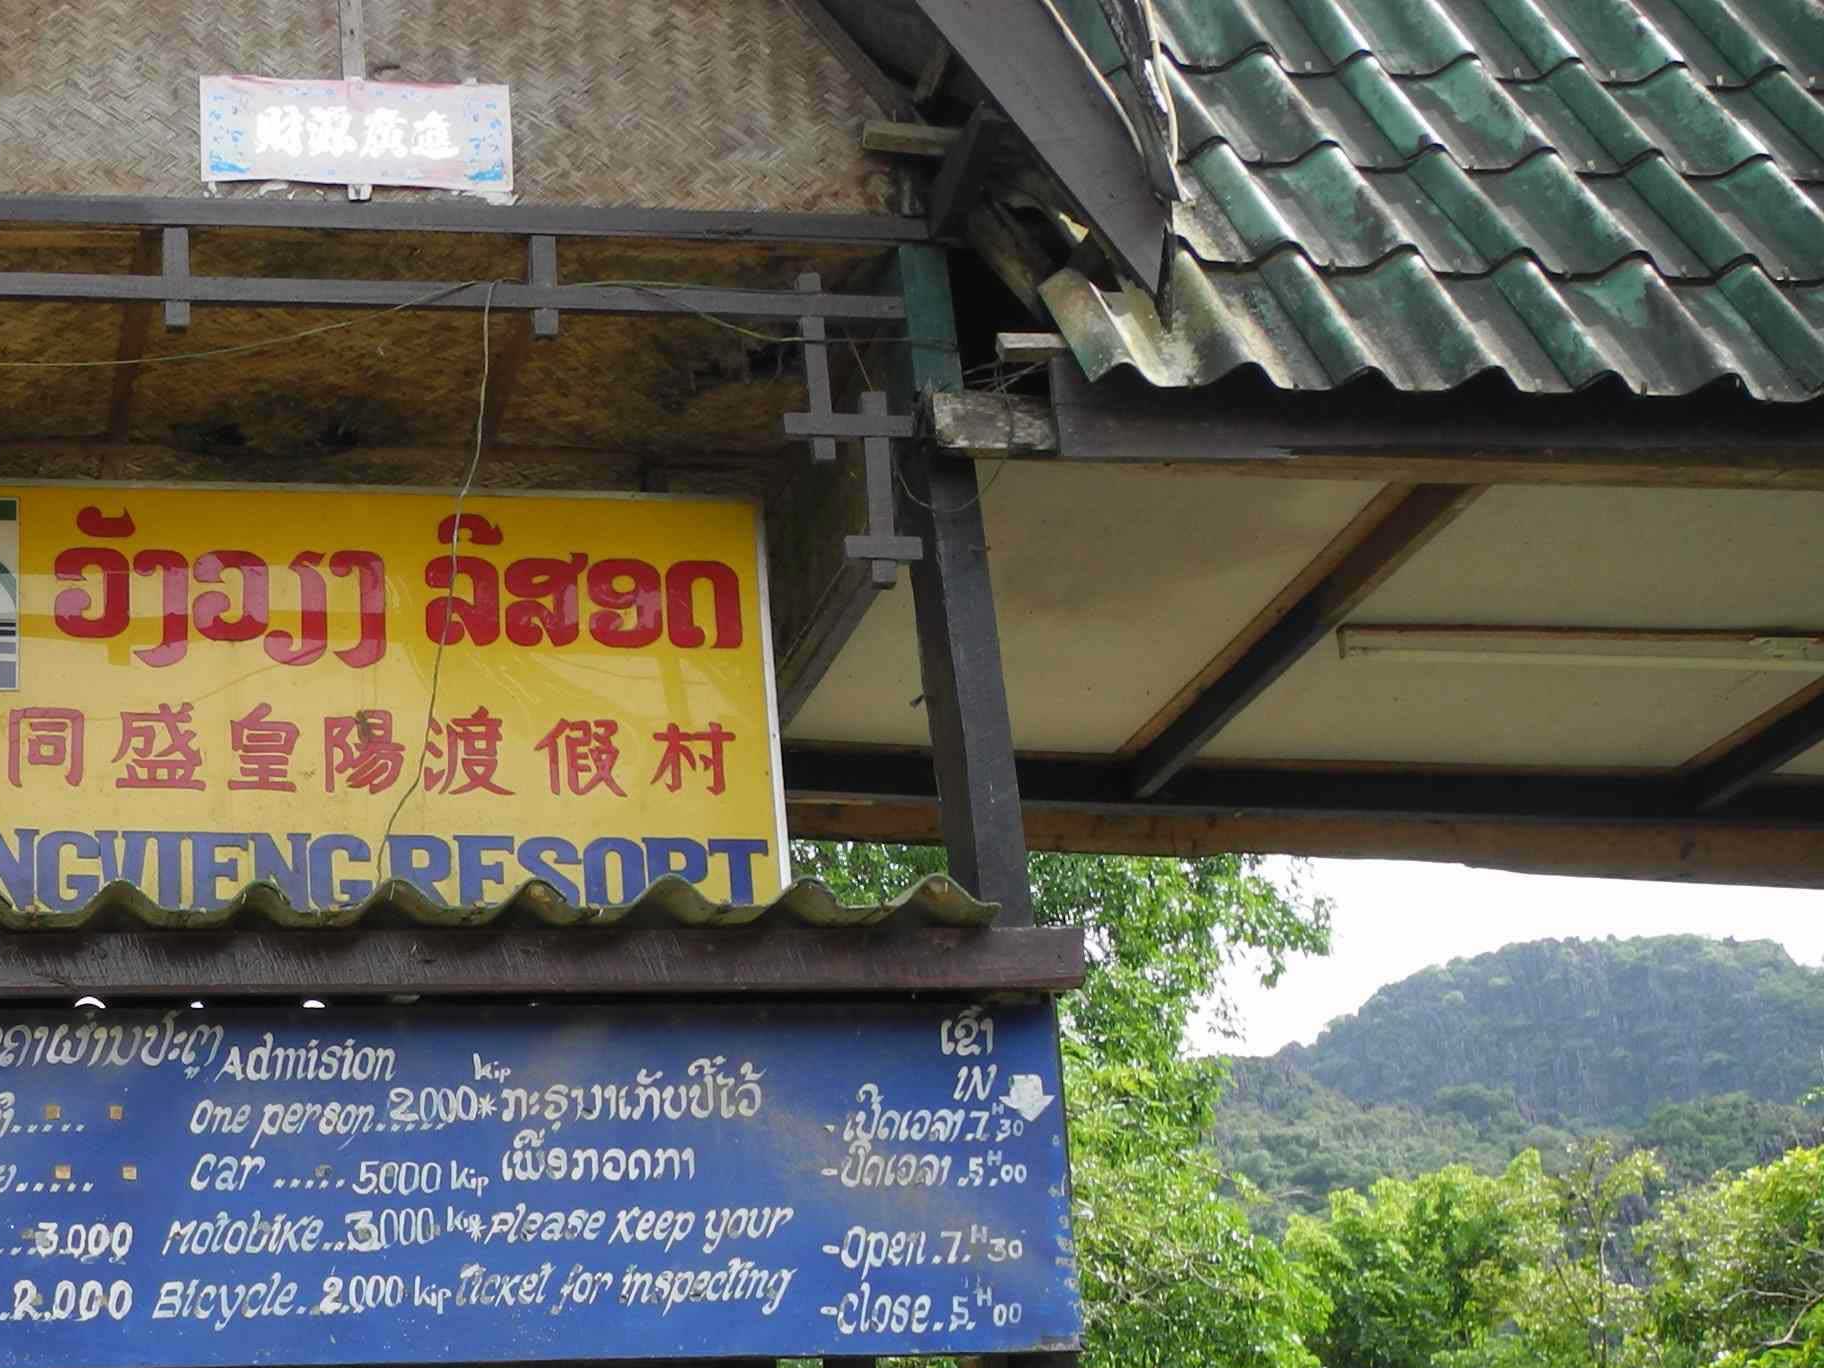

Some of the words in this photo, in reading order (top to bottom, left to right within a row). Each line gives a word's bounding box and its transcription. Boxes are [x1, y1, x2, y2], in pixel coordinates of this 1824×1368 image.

[214, 1032, 397, 1083] Admision
[952, 1063, 998, 1103] IN
[249, 1099, 376, 1151] person
[701, 1206, 795, 1254] your
[151, 1272, 301, 1332] Bicycle
[549, 1263, 614, 1315] for
